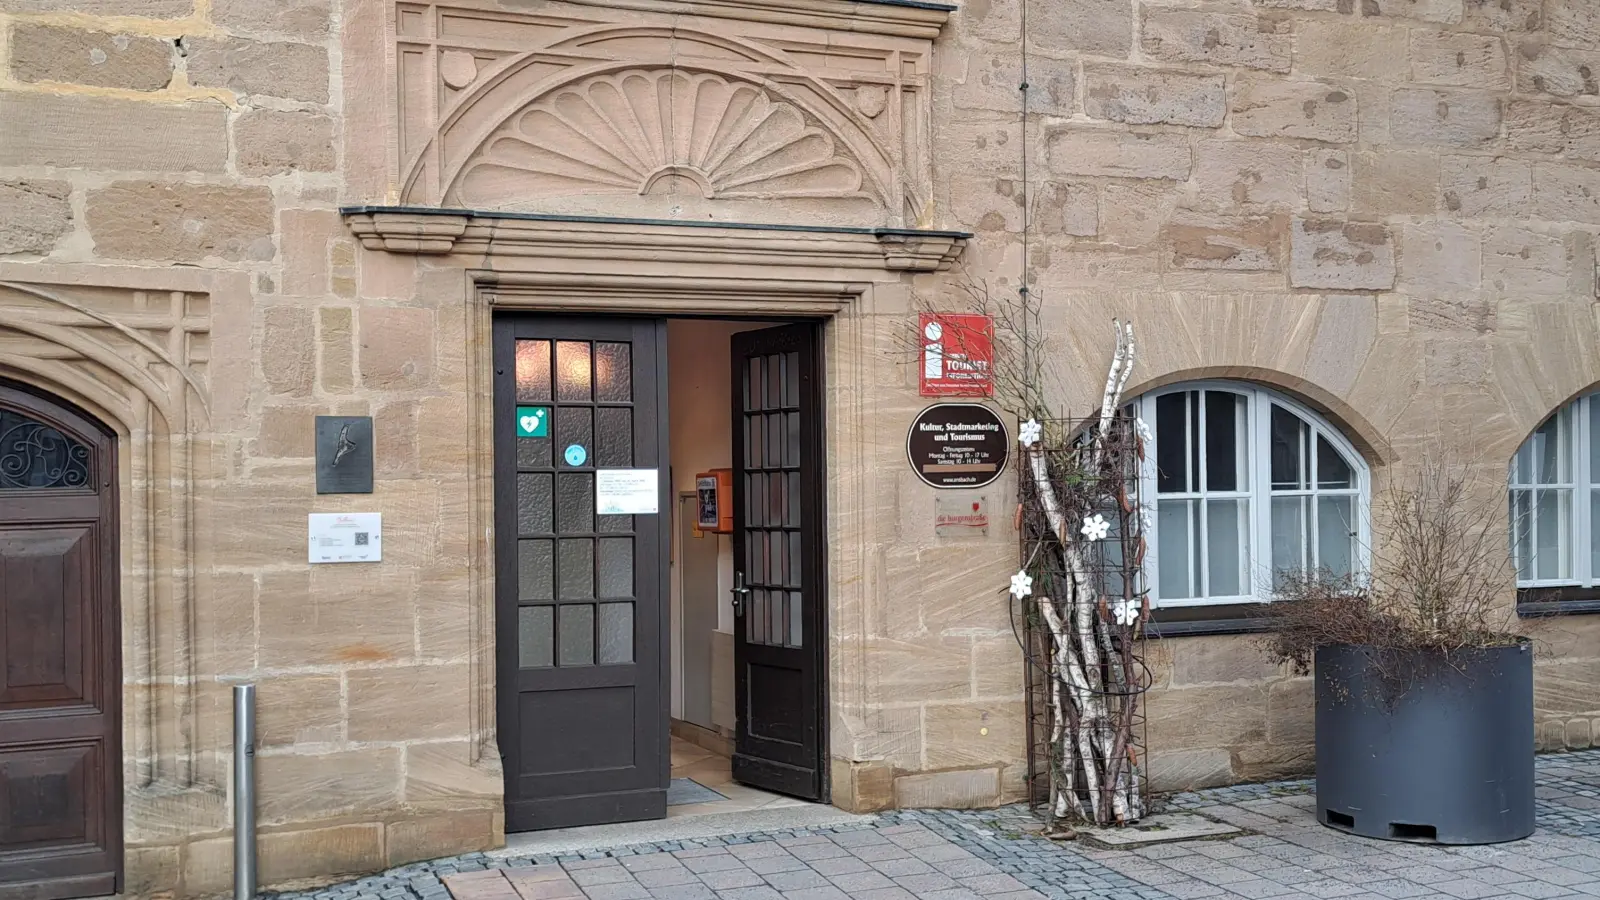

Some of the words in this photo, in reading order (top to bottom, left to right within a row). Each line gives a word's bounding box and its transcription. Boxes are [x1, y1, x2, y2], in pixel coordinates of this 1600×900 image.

[920, 423, 944, 432] Kultur,
[945, 423, 999, 432] Stadtmarketing
[934, 433, 948, 441] und
[950, 433, 985, 441] Tourismus
